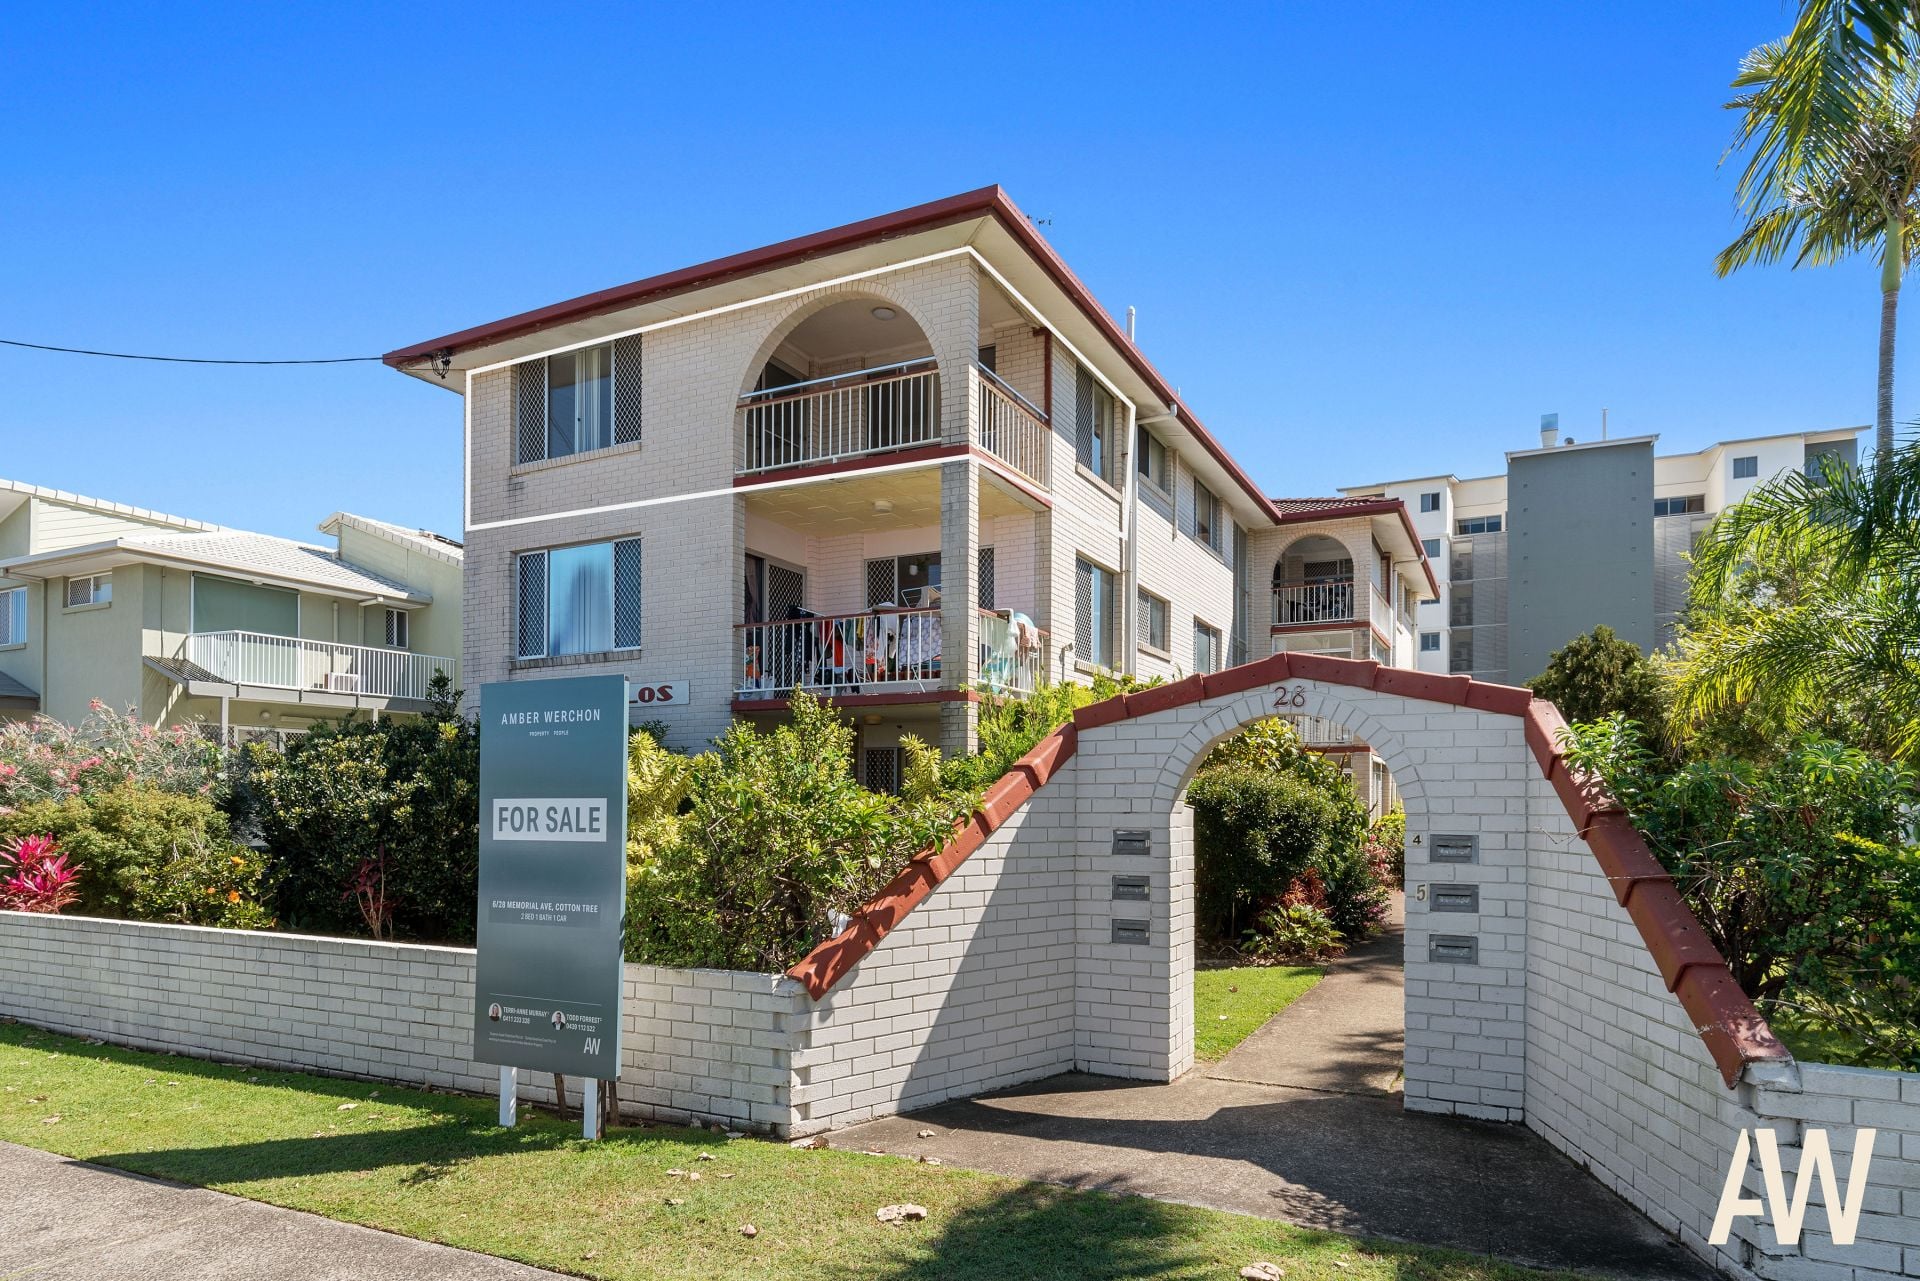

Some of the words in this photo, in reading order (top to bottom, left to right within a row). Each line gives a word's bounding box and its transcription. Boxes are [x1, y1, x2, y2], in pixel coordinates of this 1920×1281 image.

[629, 684, 674, 703] OS
[1273, 685, 1305, 707] 28
[501, 710, 540, 725] AMBER
[544, 708, 601, 723] WERCHON
[498, 806, 539, 833] FOR
[545, 806, 601, 833] SALE
[1412, 834, 1422, 845] 4
[1416, 884, 1426, 902] 5
[507, 901, 539, 910] MEMORIAL
[555, 903, 581, 912] COTTON
[582, 904, 599, 913] TREE
[525, 913, 535, 921] BED
[539, 913, 553, 921] BATH
[556, 914, 568, 922] CAR
[566, 1013, 579, 1022] TODD
[583, 1036, 601, 1056] AW
